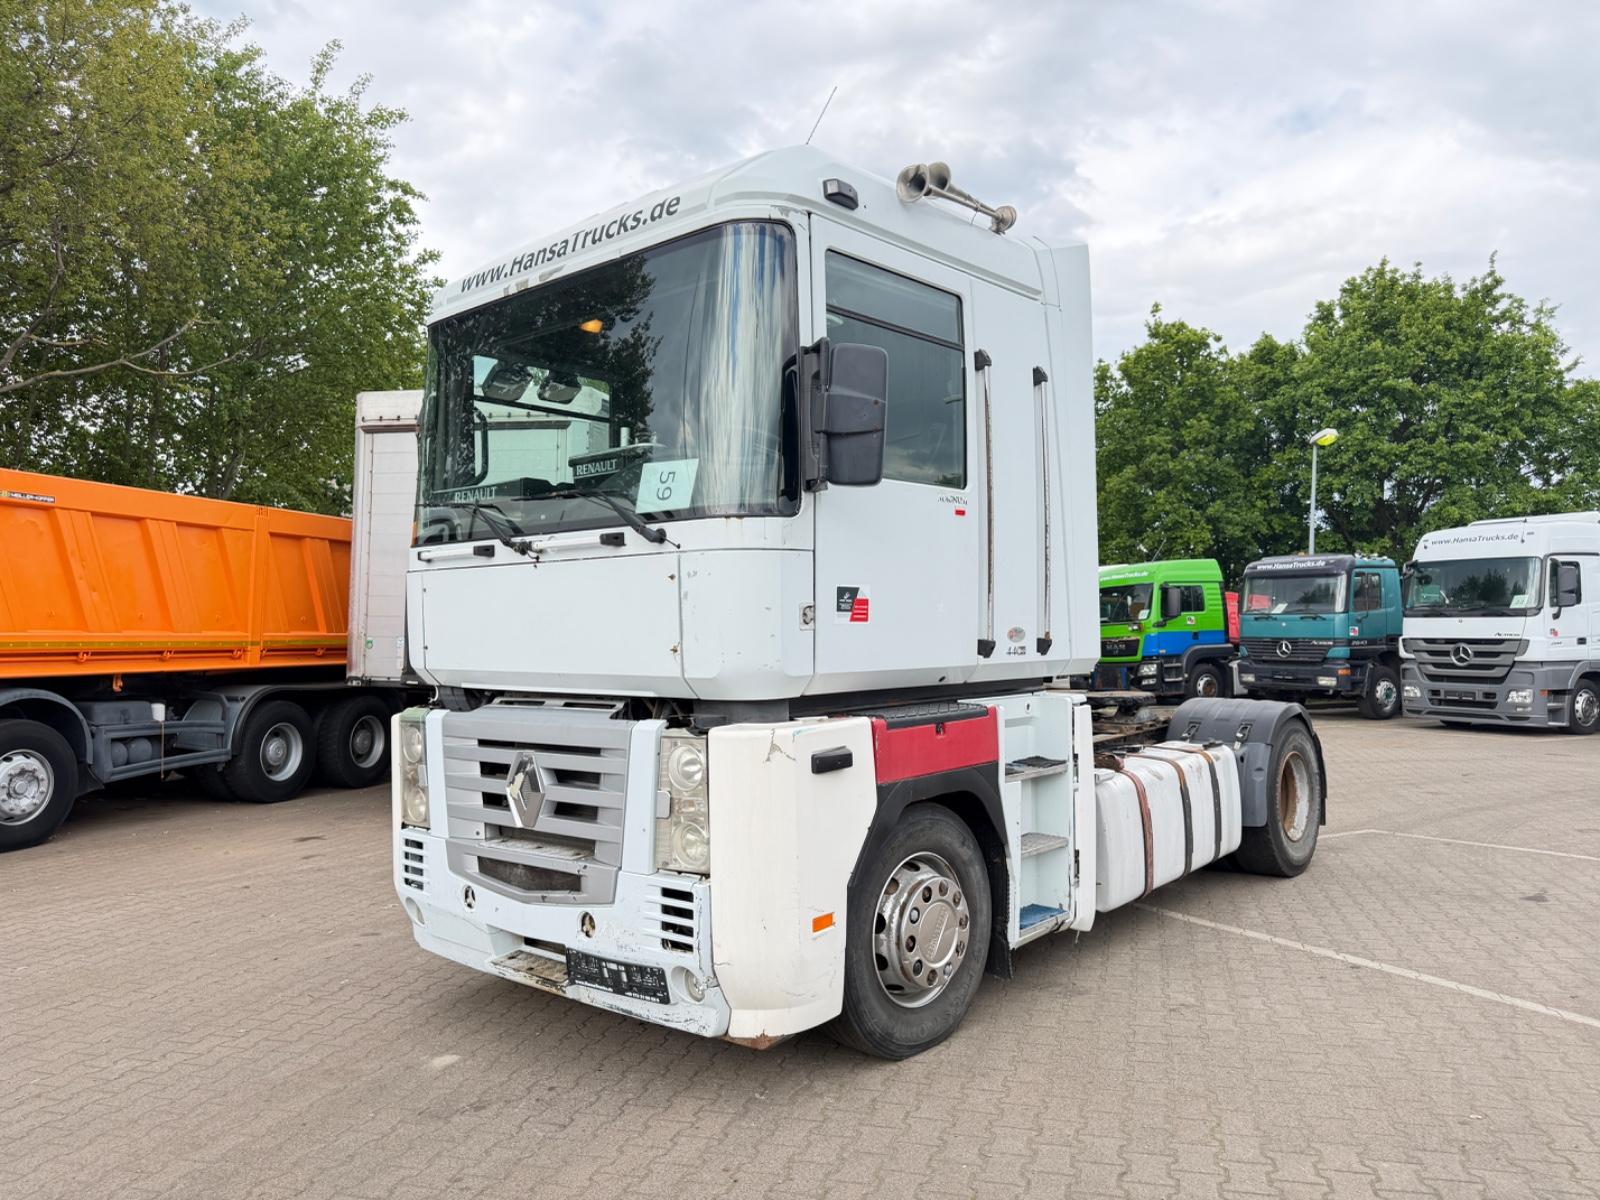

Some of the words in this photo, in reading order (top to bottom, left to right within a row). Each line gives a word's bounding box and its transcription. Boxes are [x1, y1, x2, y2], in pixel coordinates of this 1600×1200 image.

[460, 196, 681, 293] www.HansaTrucks.de
[576, 459, 618, 475] RENAULT
[656, 471, 676, 501] 59
[454, 487, 497, 503] RENAULT
[1431, 534, 1519, 546] www.HansaTrucks.de
